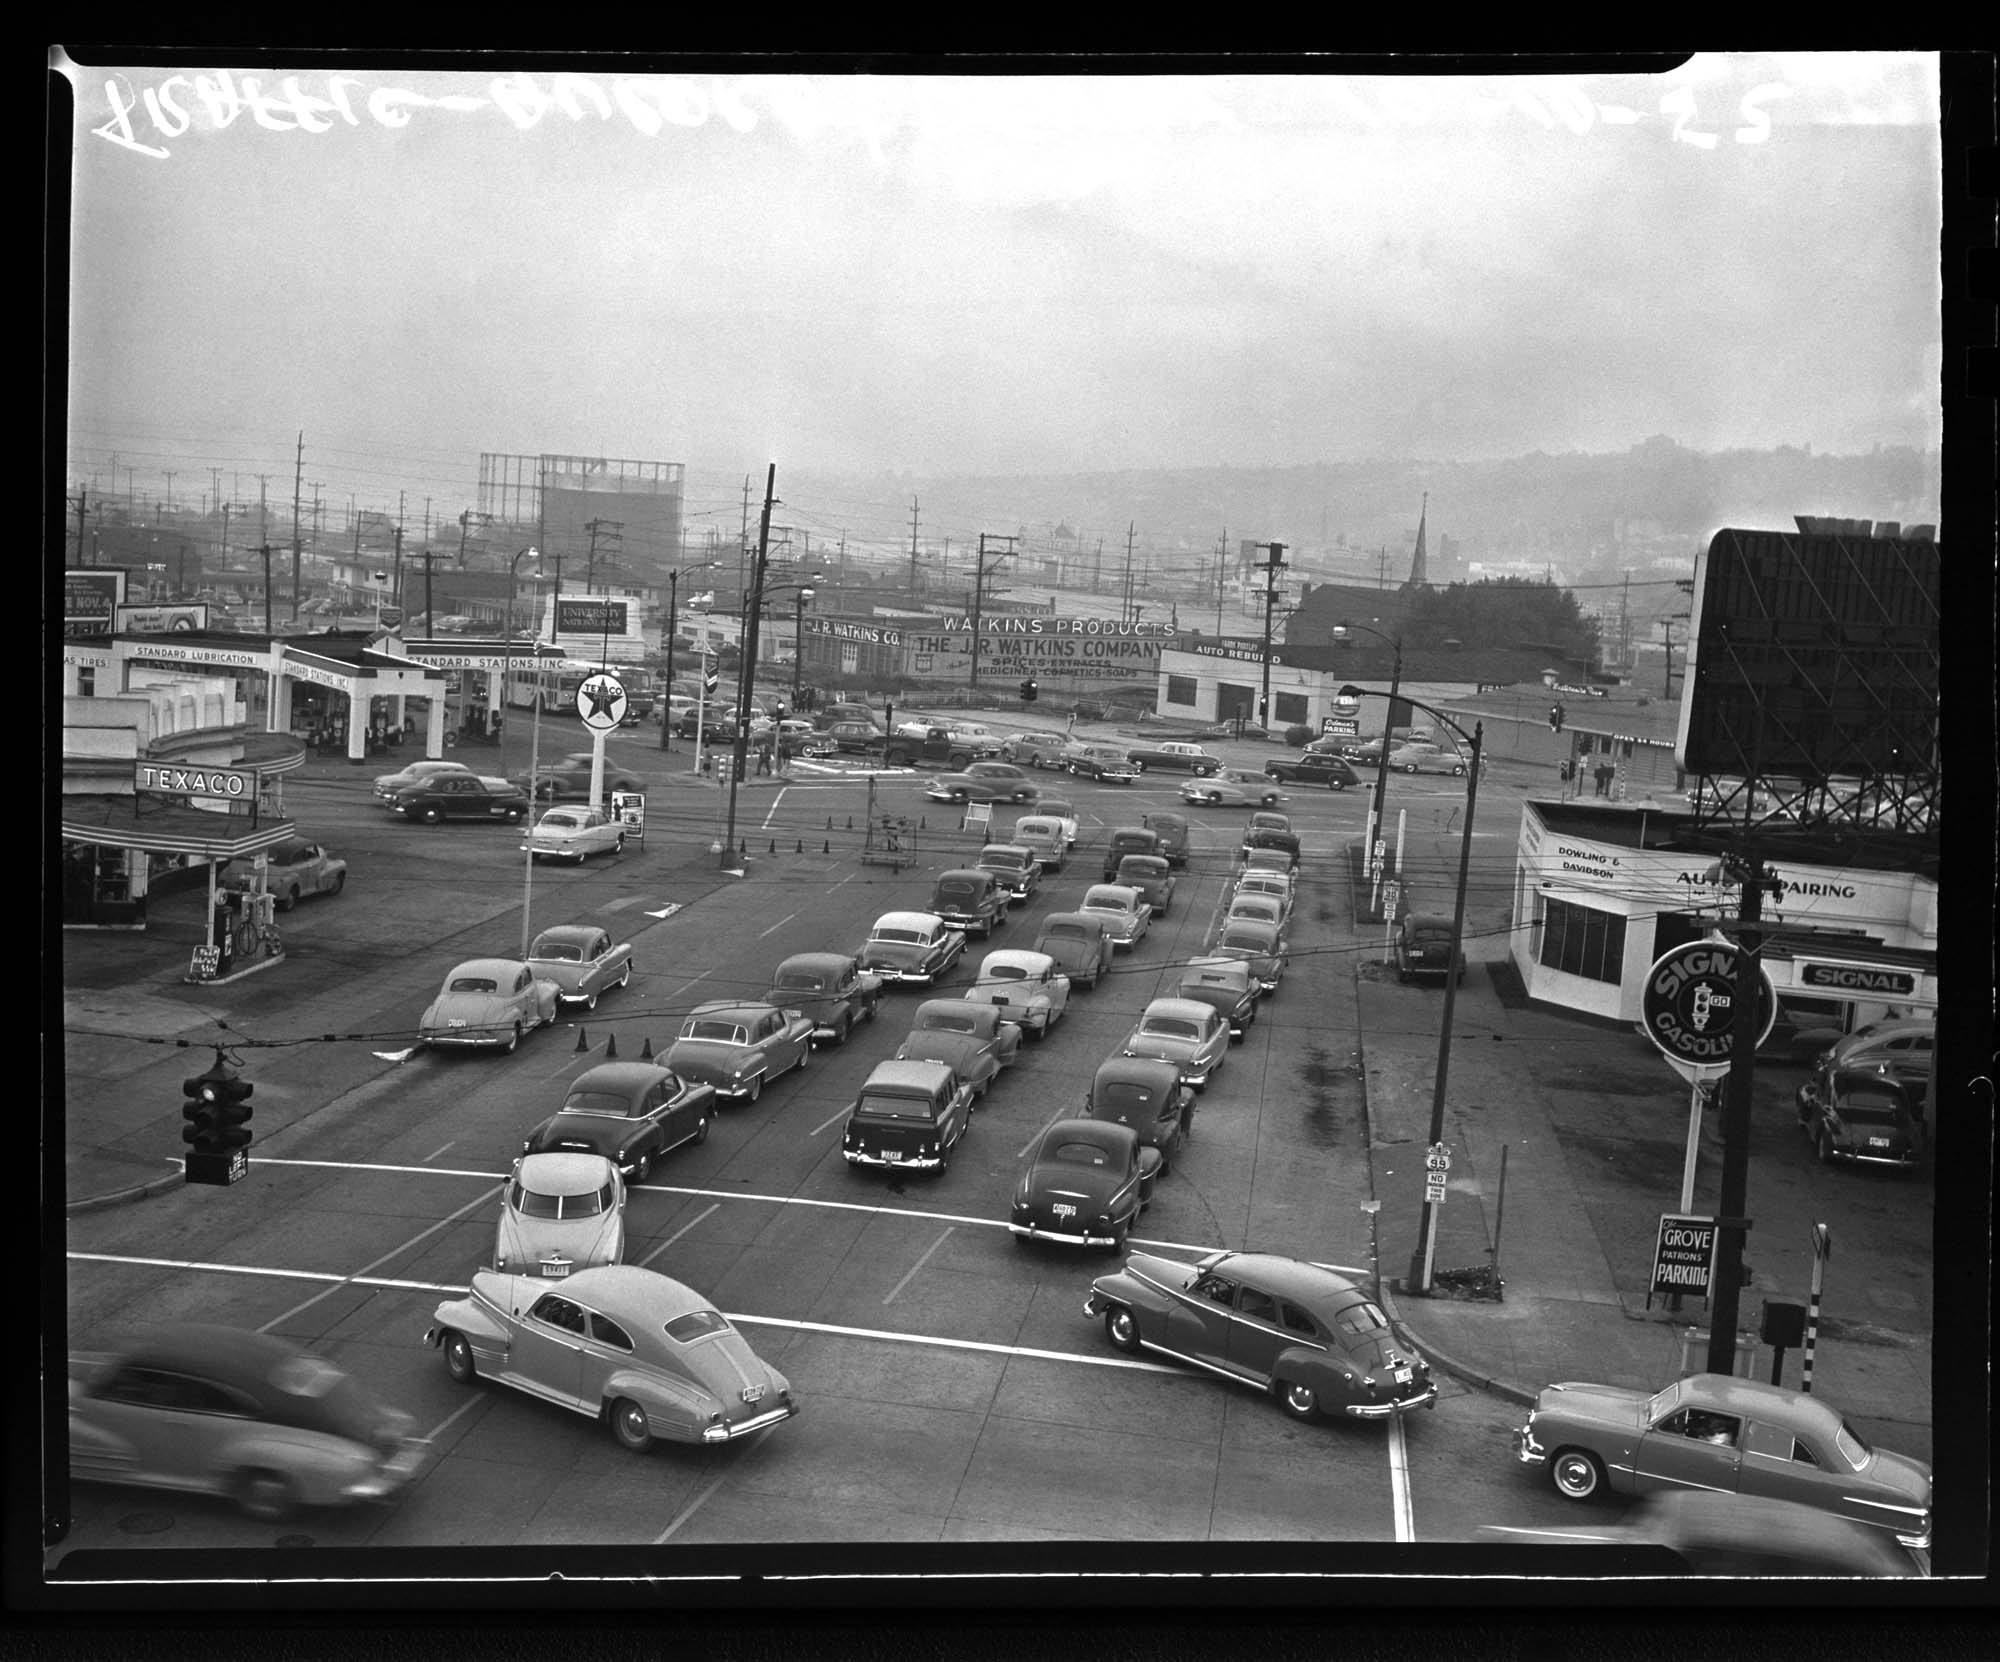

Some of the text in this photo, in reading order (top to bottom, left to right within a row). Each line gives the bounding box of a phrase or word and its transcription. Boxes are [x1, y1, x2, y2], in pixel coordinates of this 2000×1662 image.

[562, 607, 620, 618] UNIVERSITY
[834, 623, 879, 642] WATKINS
[883, 631, 901, 646] CO.
[1056, 620, 1176, 637] PRODUCTS
[137, 646, 254, 665] STANDARD LUBRICATION
[917, 636, 950, 653] THE
[998, 639, 1074, 657] WATKINS
[1083, 640, 1168, 658] COMPANY
[1196, 645, 1224, 656] AUTO
[1229, 649, 1281, 664] REBUID
[81, 657, 106, 667] TIRES
[285, 662, 309, 678] STANDARD
[408, 656, 471, 667] STANDARD
[991, 657, 1047, 667] SPICES
[1323, 725, 1356, 735] PARKING
[1613, 734, 1635, 742] OPEN
[1649, 739, 1675, 748] HOURS
[143, 767, 245, 796] TEXACO
[1558, 846, 1607, 863] DOWLING
[1562, 861, 1614, 879] DAVIDSON
[1814, 969, 1908, 992] SIGNAL
[1712, 997, 1728, 1006] GO
[1430, 1159, 1446, 1169] 99
[1431, 1174, 1443, 1183] NO
[1665, 1229, 1711, 1250] GROVE
[1656, 1263, 1708, 1286] PARKING
